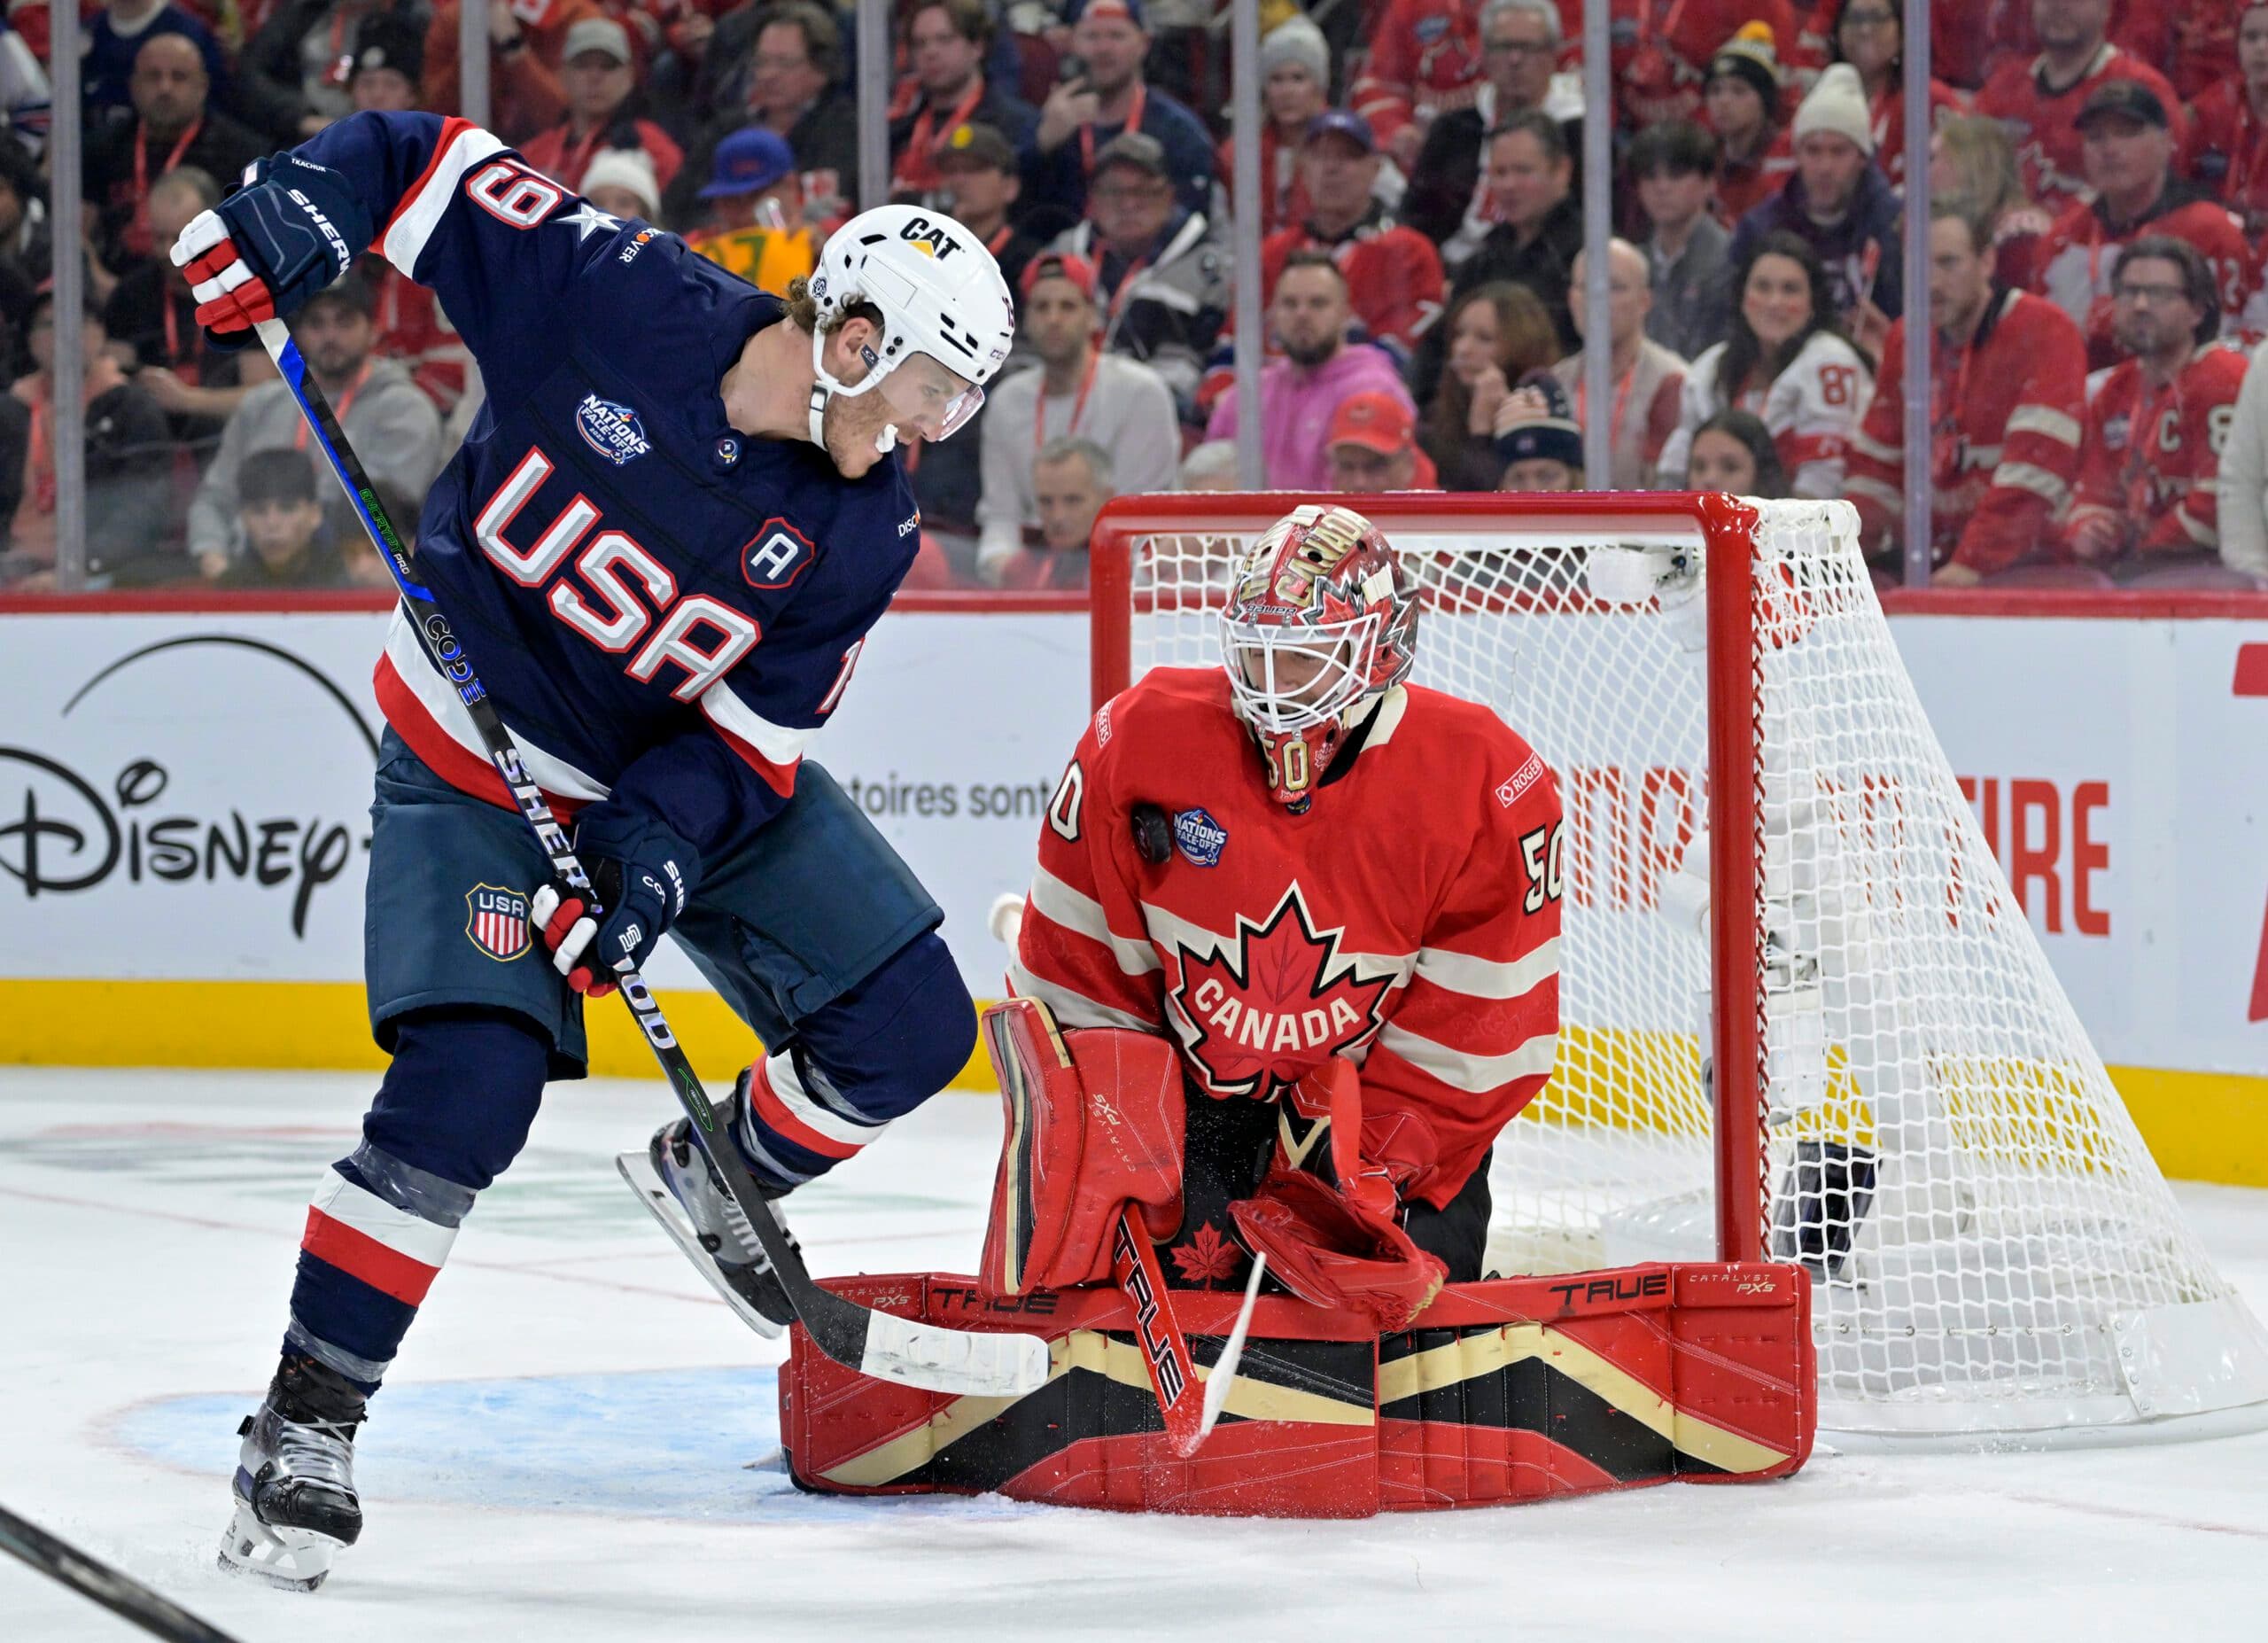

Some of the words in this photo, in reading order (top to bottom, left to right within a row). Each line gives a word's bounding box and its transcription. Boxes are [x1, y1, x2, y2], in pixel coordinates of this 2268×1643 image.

[291, 158, 327, 173] TKACHUK
[900, 217, 962, 261] CAT
[1819, 364, 1858, 413] 87
[583, 393, 651, 455] NATIONS
[2159, 409, 2182, 453] C
[392, 552, 412, 575] PRO
[473, 445, 762, 704] USA
[750, 533, 799, 581] A
[425, 613, 486, 706] CODE
[1261, 737, 1310, 791] 50
[841, 771, 959, 817] toires
[968, 776, 1052, 817] sont
[1174, 813, 1227, 845] NATIONS
[1177, 828, 1218, 853] FACE-OFF
[1518, 814, 1564, 916] 50
[478, 892, 525, 918] USA
[1194, 977, 1361, 1053] CANADA
[835, 1286, 905, 1299] ATALYST
[1548, 1273, 1667, 1306] TRUE
[1689, 1273, 1772, 1283] CATALYST
[1114, 1213, 1185, 1411] TRUE
